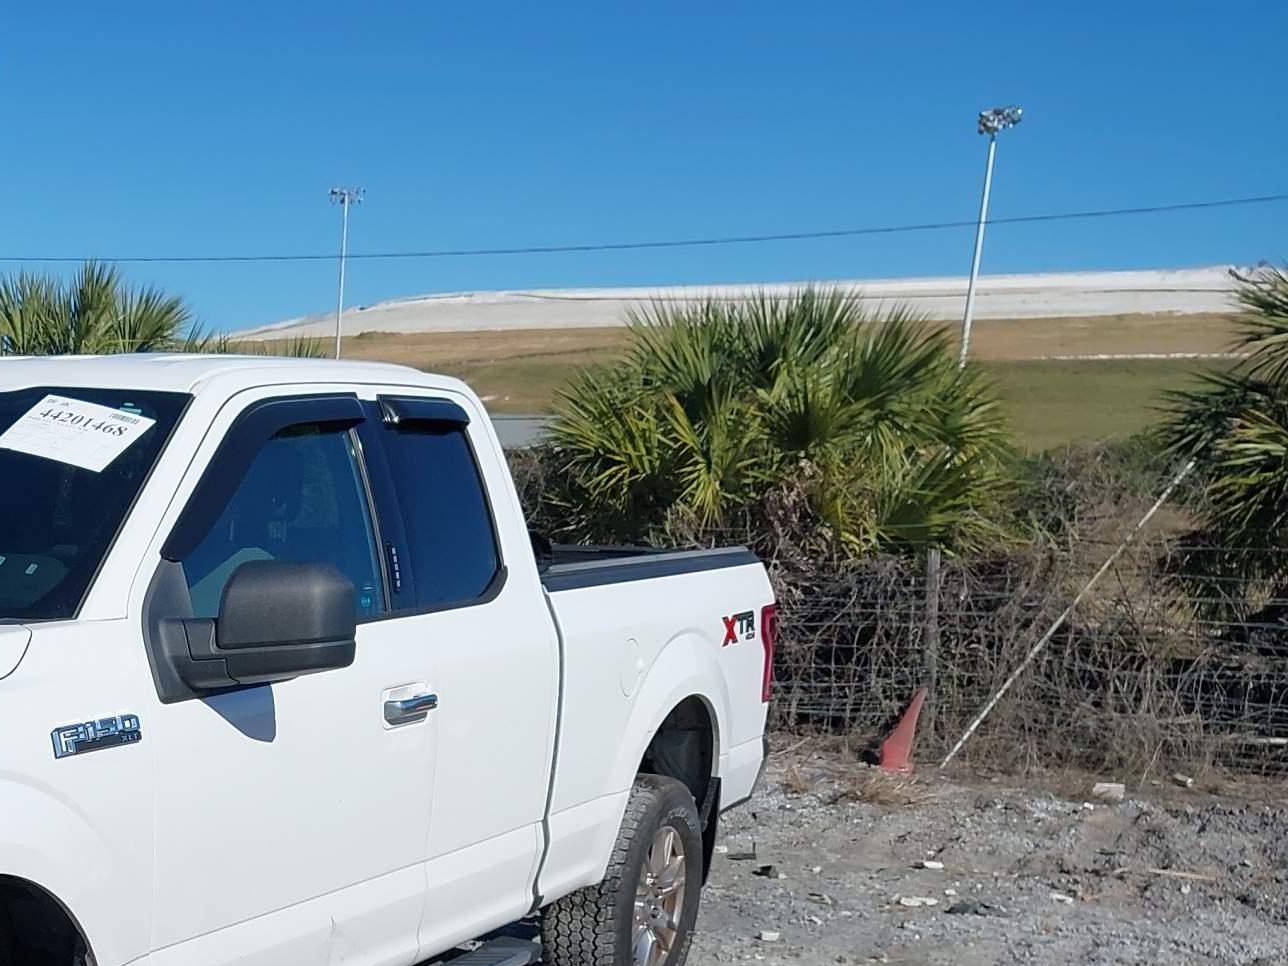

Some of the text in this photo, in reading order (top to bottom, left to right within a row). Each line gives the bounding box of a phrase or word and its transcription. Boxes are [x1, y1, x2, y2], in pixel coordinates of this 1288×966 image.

[39, 407, 128, 437] 44201468
[721, 610, 756, 647] XTR
[120, 732, 140, 743] XLT
